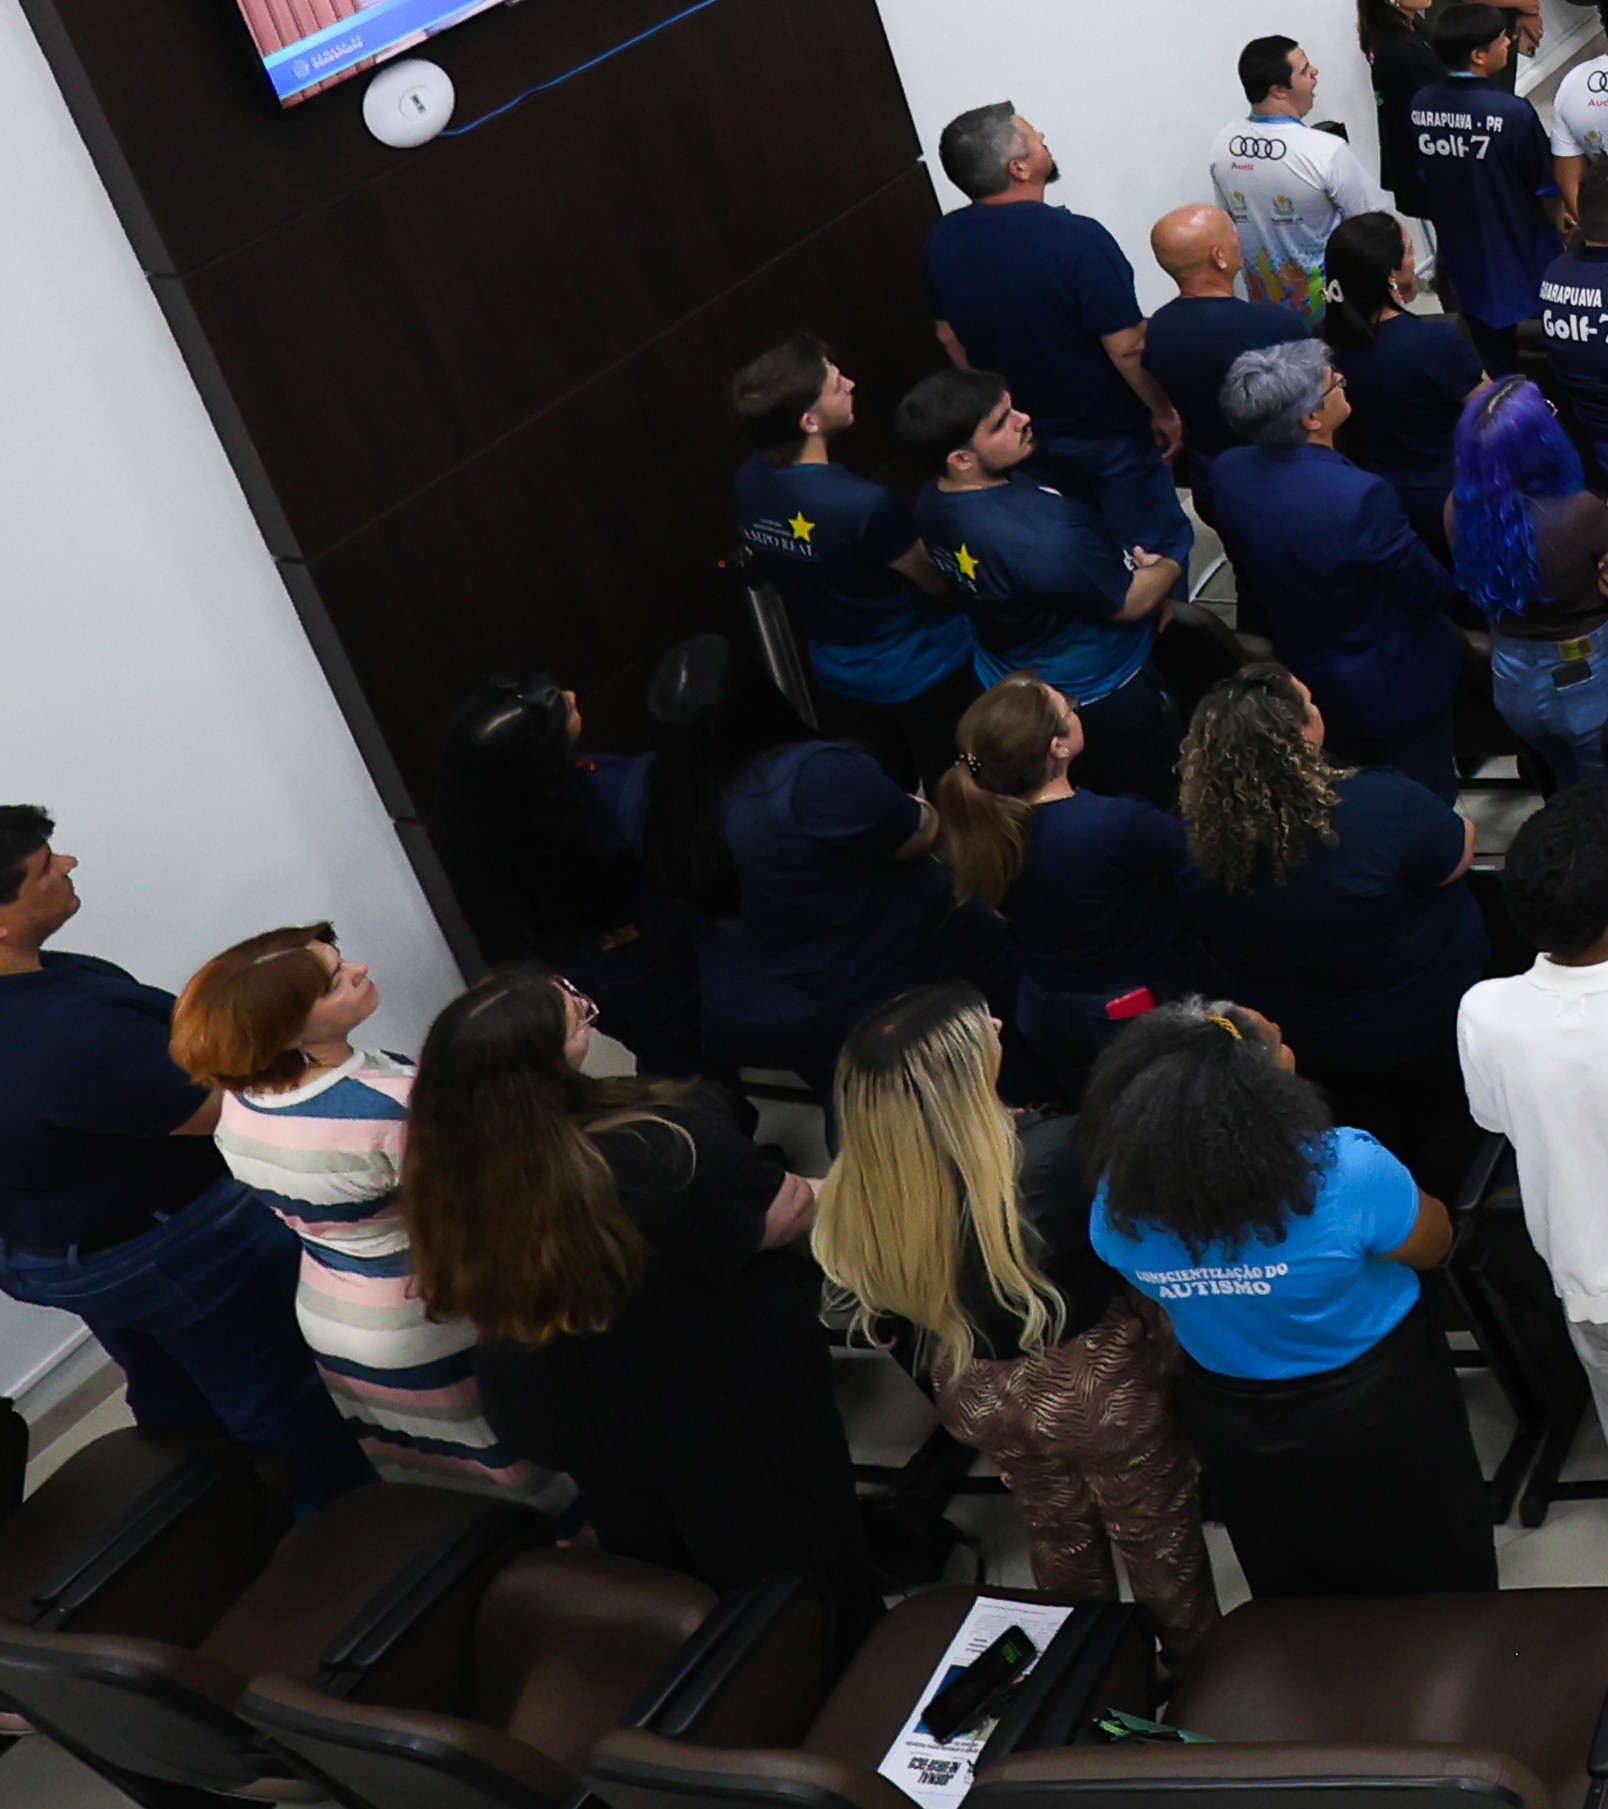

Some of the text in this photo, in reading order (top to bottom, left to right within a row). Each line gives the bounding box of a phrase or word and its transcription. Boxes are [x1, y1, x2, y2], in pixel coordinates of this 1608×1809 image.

[1485, 115, 1503, 133] PR
[1264, 1262, 1289, 1279] DO
[1159, 1279, 1272, 1299] AUTISMO
